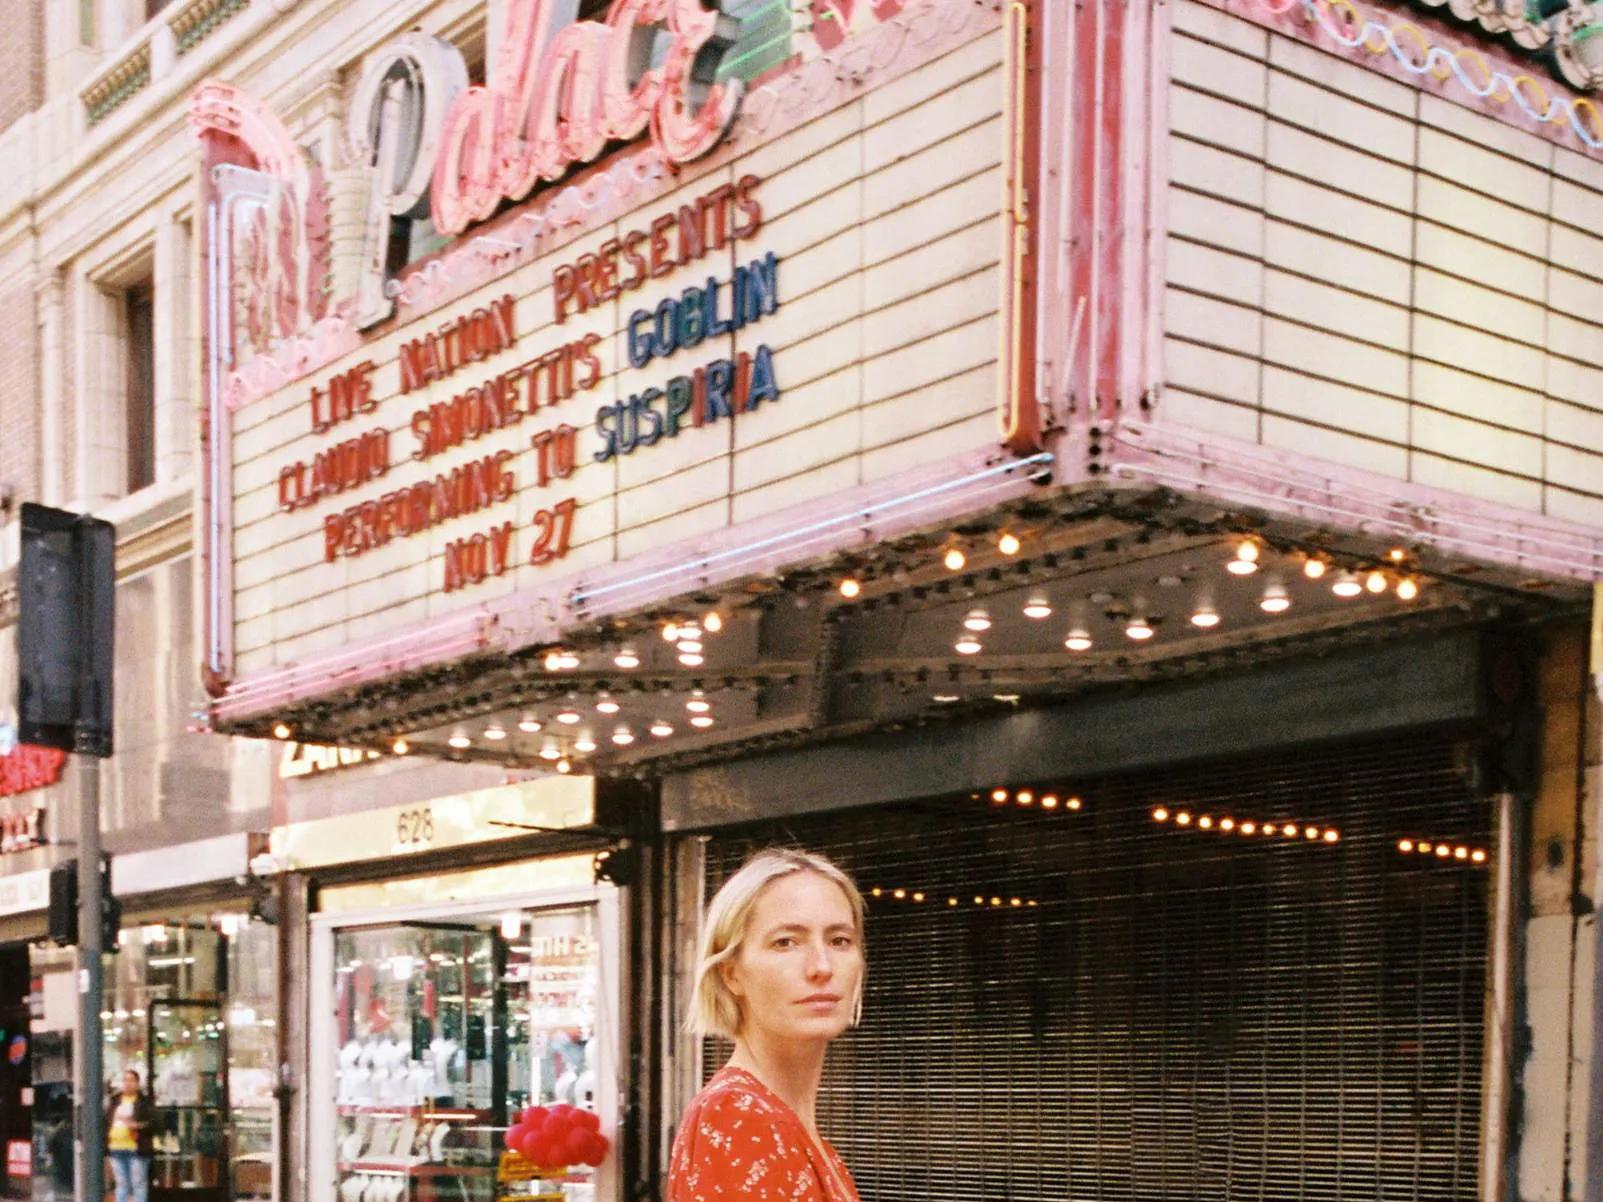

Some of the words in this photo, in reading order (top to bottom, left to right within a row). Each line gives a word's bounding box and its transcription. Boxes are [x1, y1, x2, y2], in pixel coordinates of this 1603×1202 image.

[278, 427, 391, 513] CLAUDIO
[627, 251, 780, 369] GOBLIN
[310, 361, 377, 434] LIVE
[401, 294, 516, 395] NATION
[553, 174, 761, 325] PRESENTS
[324, 449, 514, 563] PERFORMING
[531, 423, 577, 488] TO
[593, 344, 781, 463] SUSPIRIA
[443, 521, 512, 593] NOV
[529, 498, 577, 566] 27
[397, 808, 434, 844] 628
